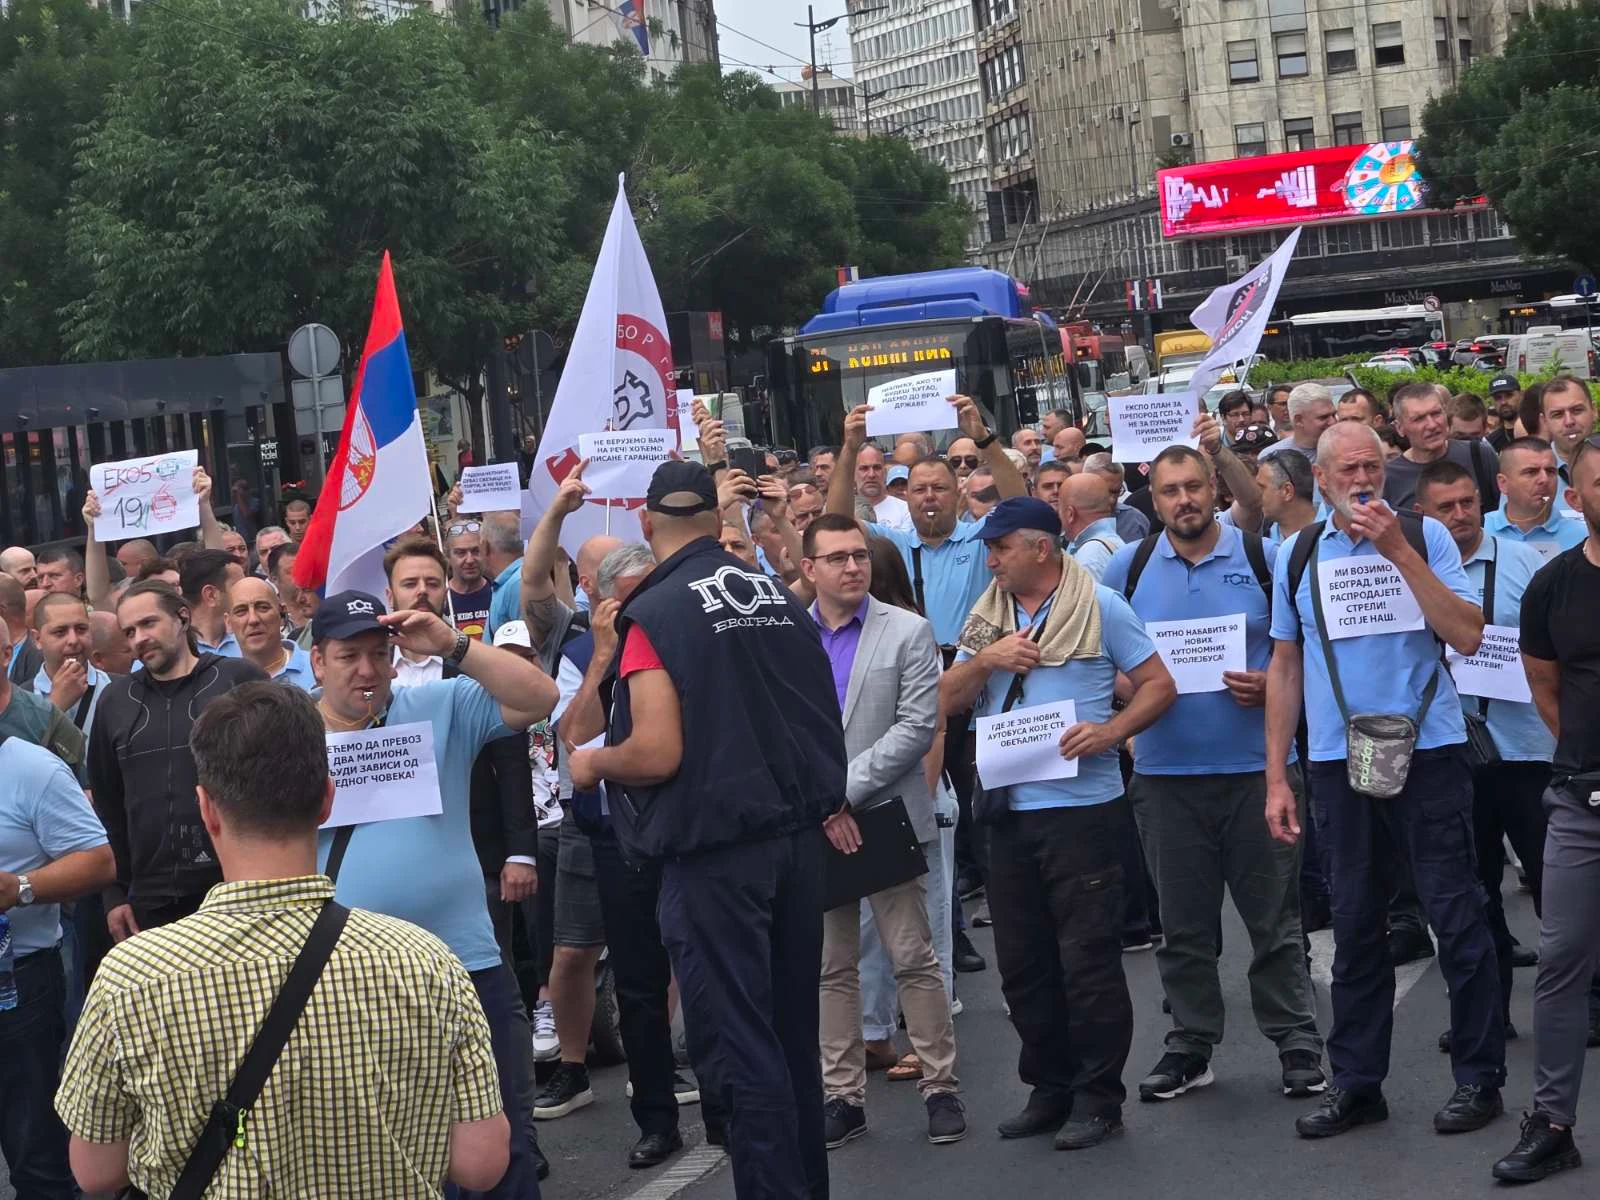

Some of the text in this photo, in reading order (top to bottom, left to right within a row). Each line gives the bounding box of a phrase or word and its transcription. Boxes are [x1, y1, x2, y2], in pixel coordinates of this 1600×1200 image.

[922, 391, 940, 399] ВРХА
[894, 401, 928, 409] ДРЖАВЕ!
[1125, 403, 1149, 411] ЕКСПО
[1119, 411, 1158, 420] ПРЕПОРОД
[1150, 418, 1183, 426] ПУЊЕЊЕ
[1135, 426, 1179, 436] ПРИВАТНИХ
[590, 455, 621, 463] ПИСАНЕ
[1334, 564, 1393, 577] МИ ВОЗИМО
[1329, 575, 1401, 591] БЕОГРАД, ВИ ГА
[1330, 587, 1402, 603] РАСПРОДАЈЕТЕ
[1345, 601, 1387, 613] СТРЕЛИ!
[1338, 613, 1397, 627] ГСП ЈЕ НАШ.
[1155, 630, 1184, 638] ХИТНО
[1186, 625, 1227, 636] НАБАВИТЕ
[1184, 637, 1213, 646] НОВИХ
[1170, 644, 1226, 656] АУТОНОМНИХ
[1479, 651, 1517, 663] ТИ НАШИ
[1463, 658, 1504, 670] ЗАХТЕВИ!
[991, 711, 1061, 731] ГДЕ ЈЕ 300 НОВИХ
[987, 720, 1066, 741] АУТОБУСА КОЈЕ СТЕ
[365, 740, 379, 750] ДА
[382, 735, 422, 747] ПРЕВОЗ
[1000, 732, 1052, 747] ОБЕЋАЛИ???
[333, 748, 410, 766] ДВА МИЛИОНА
[360, 761, 401, 773] ЗАВИСИ
[403, 758, 419, 768] ОД
[371, 770, 415, 783] ЧОВЕКА!
